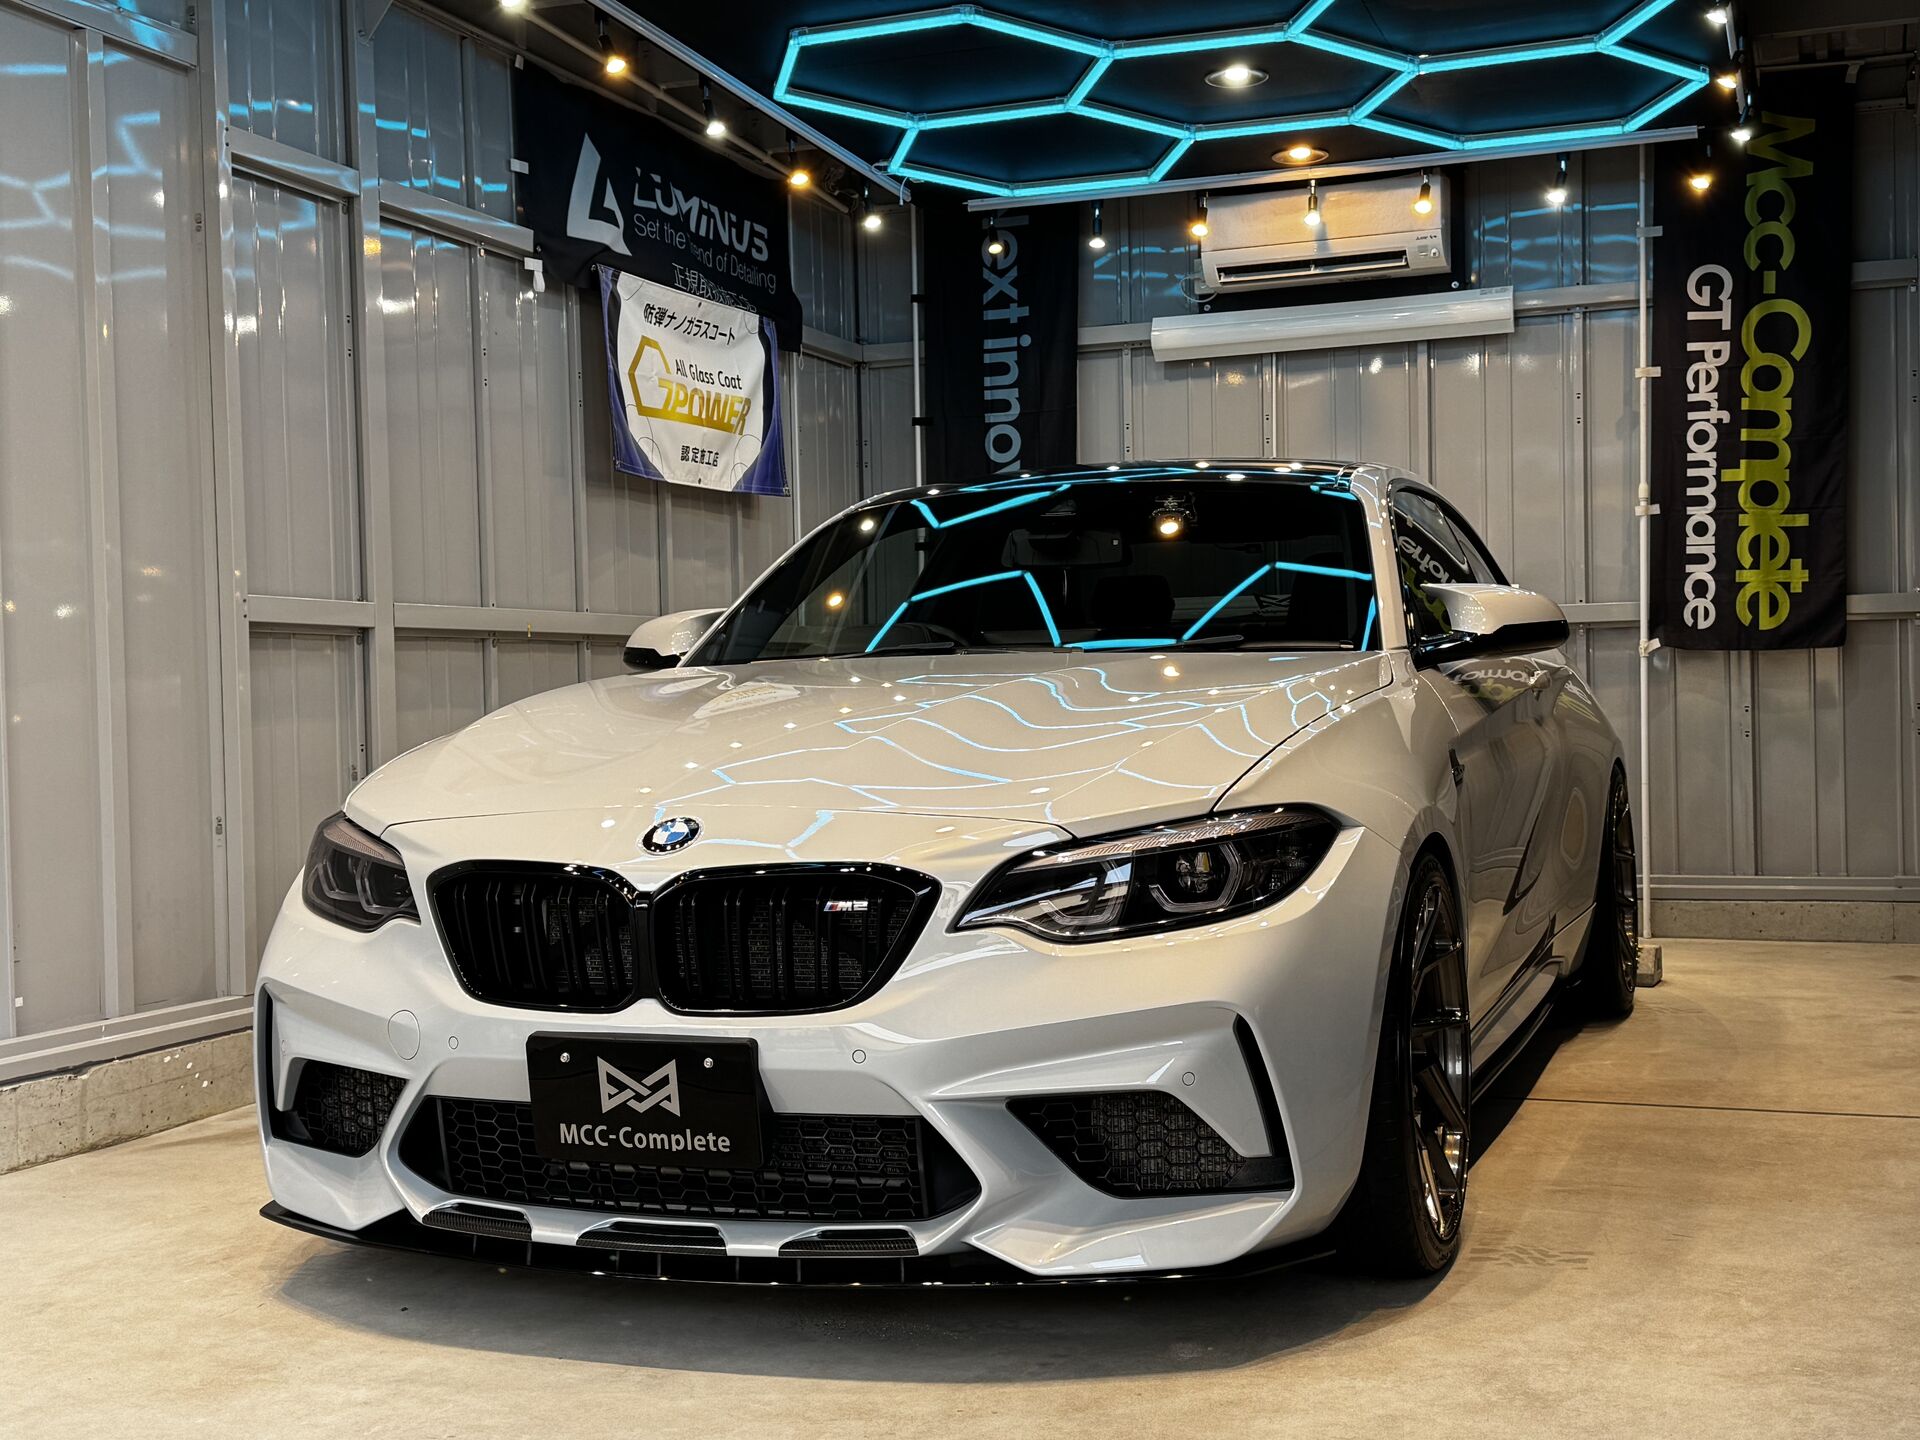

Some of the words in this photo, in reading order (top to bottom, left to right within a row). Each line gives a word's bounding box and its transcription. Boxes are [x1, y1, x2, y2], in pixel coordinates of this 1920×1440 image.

[633, 166, 769, 262] LUMINUS
[633, 213, 661, 241] Set
[663, 222, 687, 250] the
[687, 232, 713, 268] rend
[716, 251, 728, 273] of
[730, 253, 777, 295] Detailing
[643, 303, 735, 345] 防弾ナノガラスコート
[1686, 263, 1734, 331] GT
[675, 359, 687, 378] All
[689, 363, 715, 386] Glass
[718, 370, 743, 390] Coat
[1683, 340, 1731, 630] Performance
[837, 900, 869, 912] M2
[559, 1122, 731, 1153] MCC-Complete
